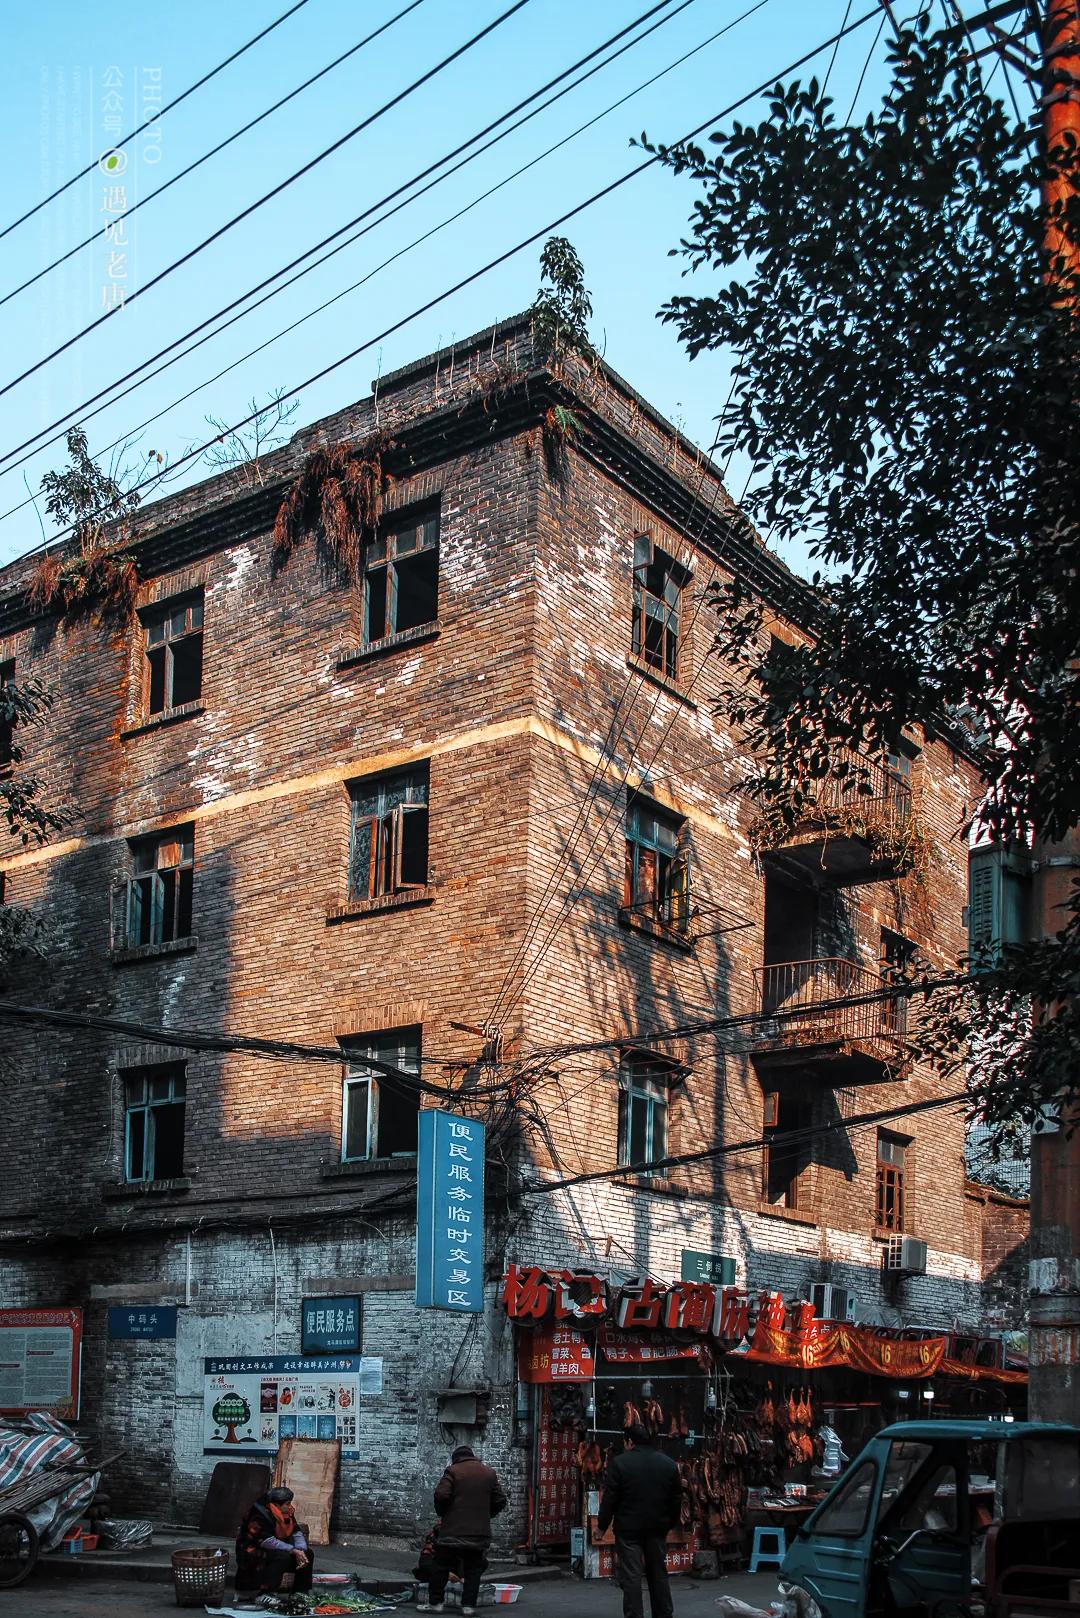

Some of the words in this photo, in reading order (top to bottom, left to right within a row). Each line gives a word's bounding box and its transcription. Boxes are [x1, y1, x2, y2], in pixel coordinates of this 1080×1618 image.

[446, 1122, 474, 1306] 便民服务临时交易区
[306, 1308, 355, 1333] 便民服务点
